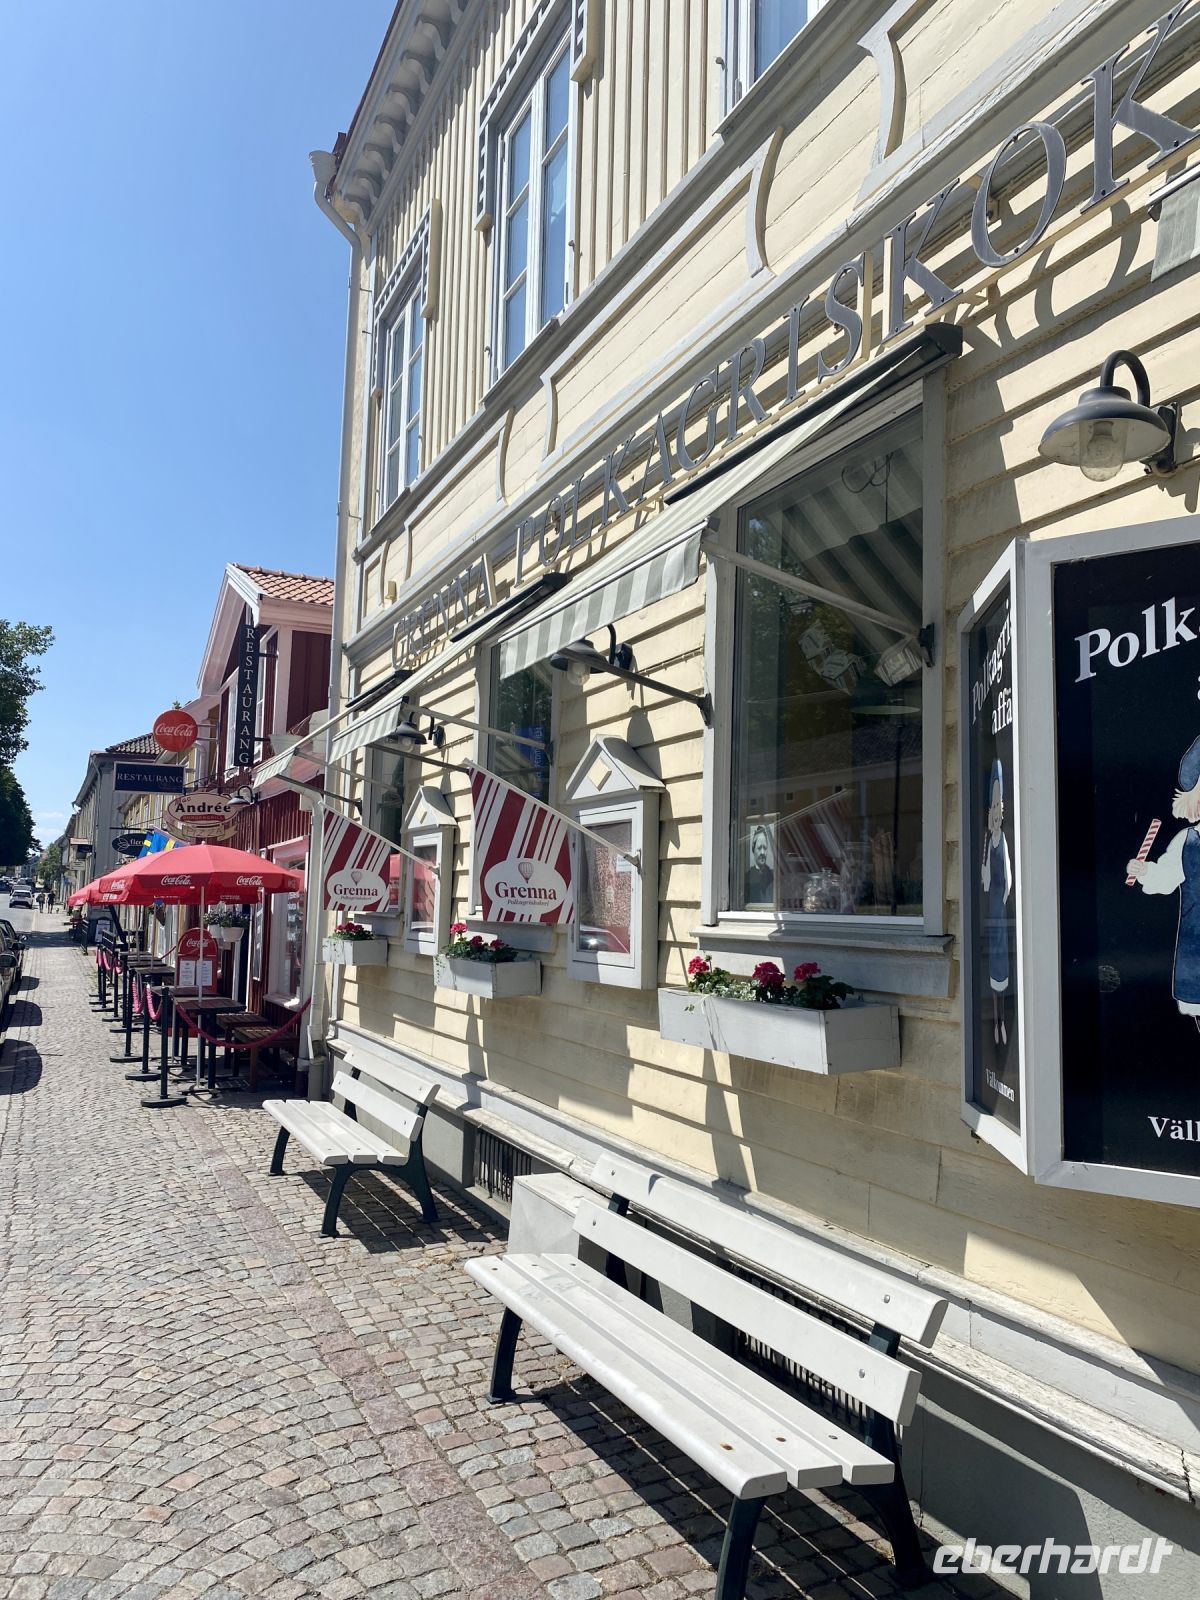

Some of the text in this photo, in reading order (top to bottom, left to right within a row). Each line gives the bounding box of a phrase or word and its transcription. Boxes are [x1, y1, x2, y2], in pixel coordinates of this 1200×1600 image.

[1075, 596, 1200, 683] Polk
[238, 628, 256, 764] RESTAURANG
[155, 723, 194, 737] Coca-Cola
[117, 773, 183, 783] RESTAURANG
[175, 802, 231, 813] Andrée
[161, 875, 192, 886] Coca-Cola
[236, 875, 264, 886] Coca-Cola
[333, 883, 378, 897] Grenna
[495, 881, 557, 900] Grenna
